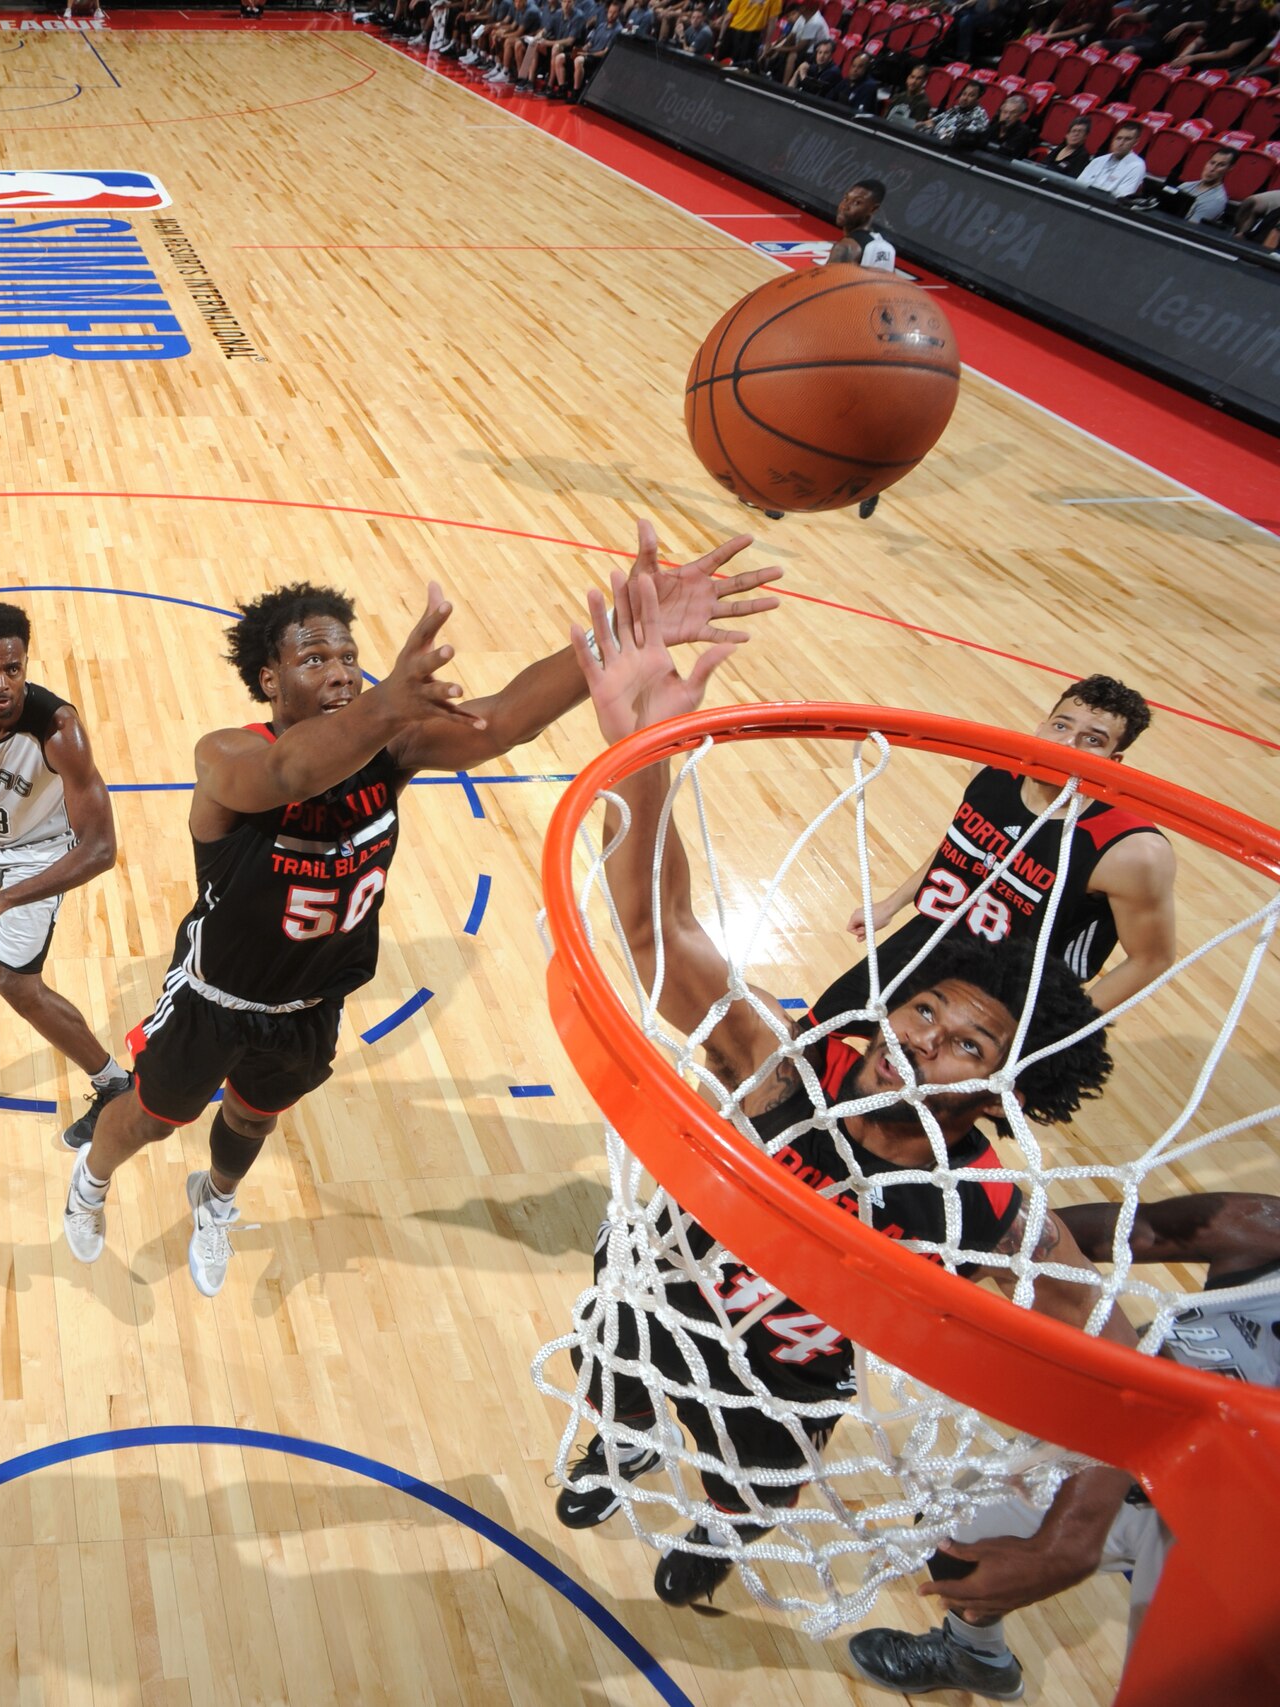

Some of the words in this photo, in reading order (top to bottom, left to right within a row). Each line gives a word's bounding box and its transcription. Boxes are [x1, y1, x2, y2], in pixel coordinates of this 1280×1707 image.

[150, 218, 184, 235] MGM
[929, 190, 1047, 272] NBPA
[161, 238, 208, 275] RESORTS
[272, 853, 331, 879] TRAIL
[282, 866, 388, 941] 50
[915, 867, 1012, 943] 28
